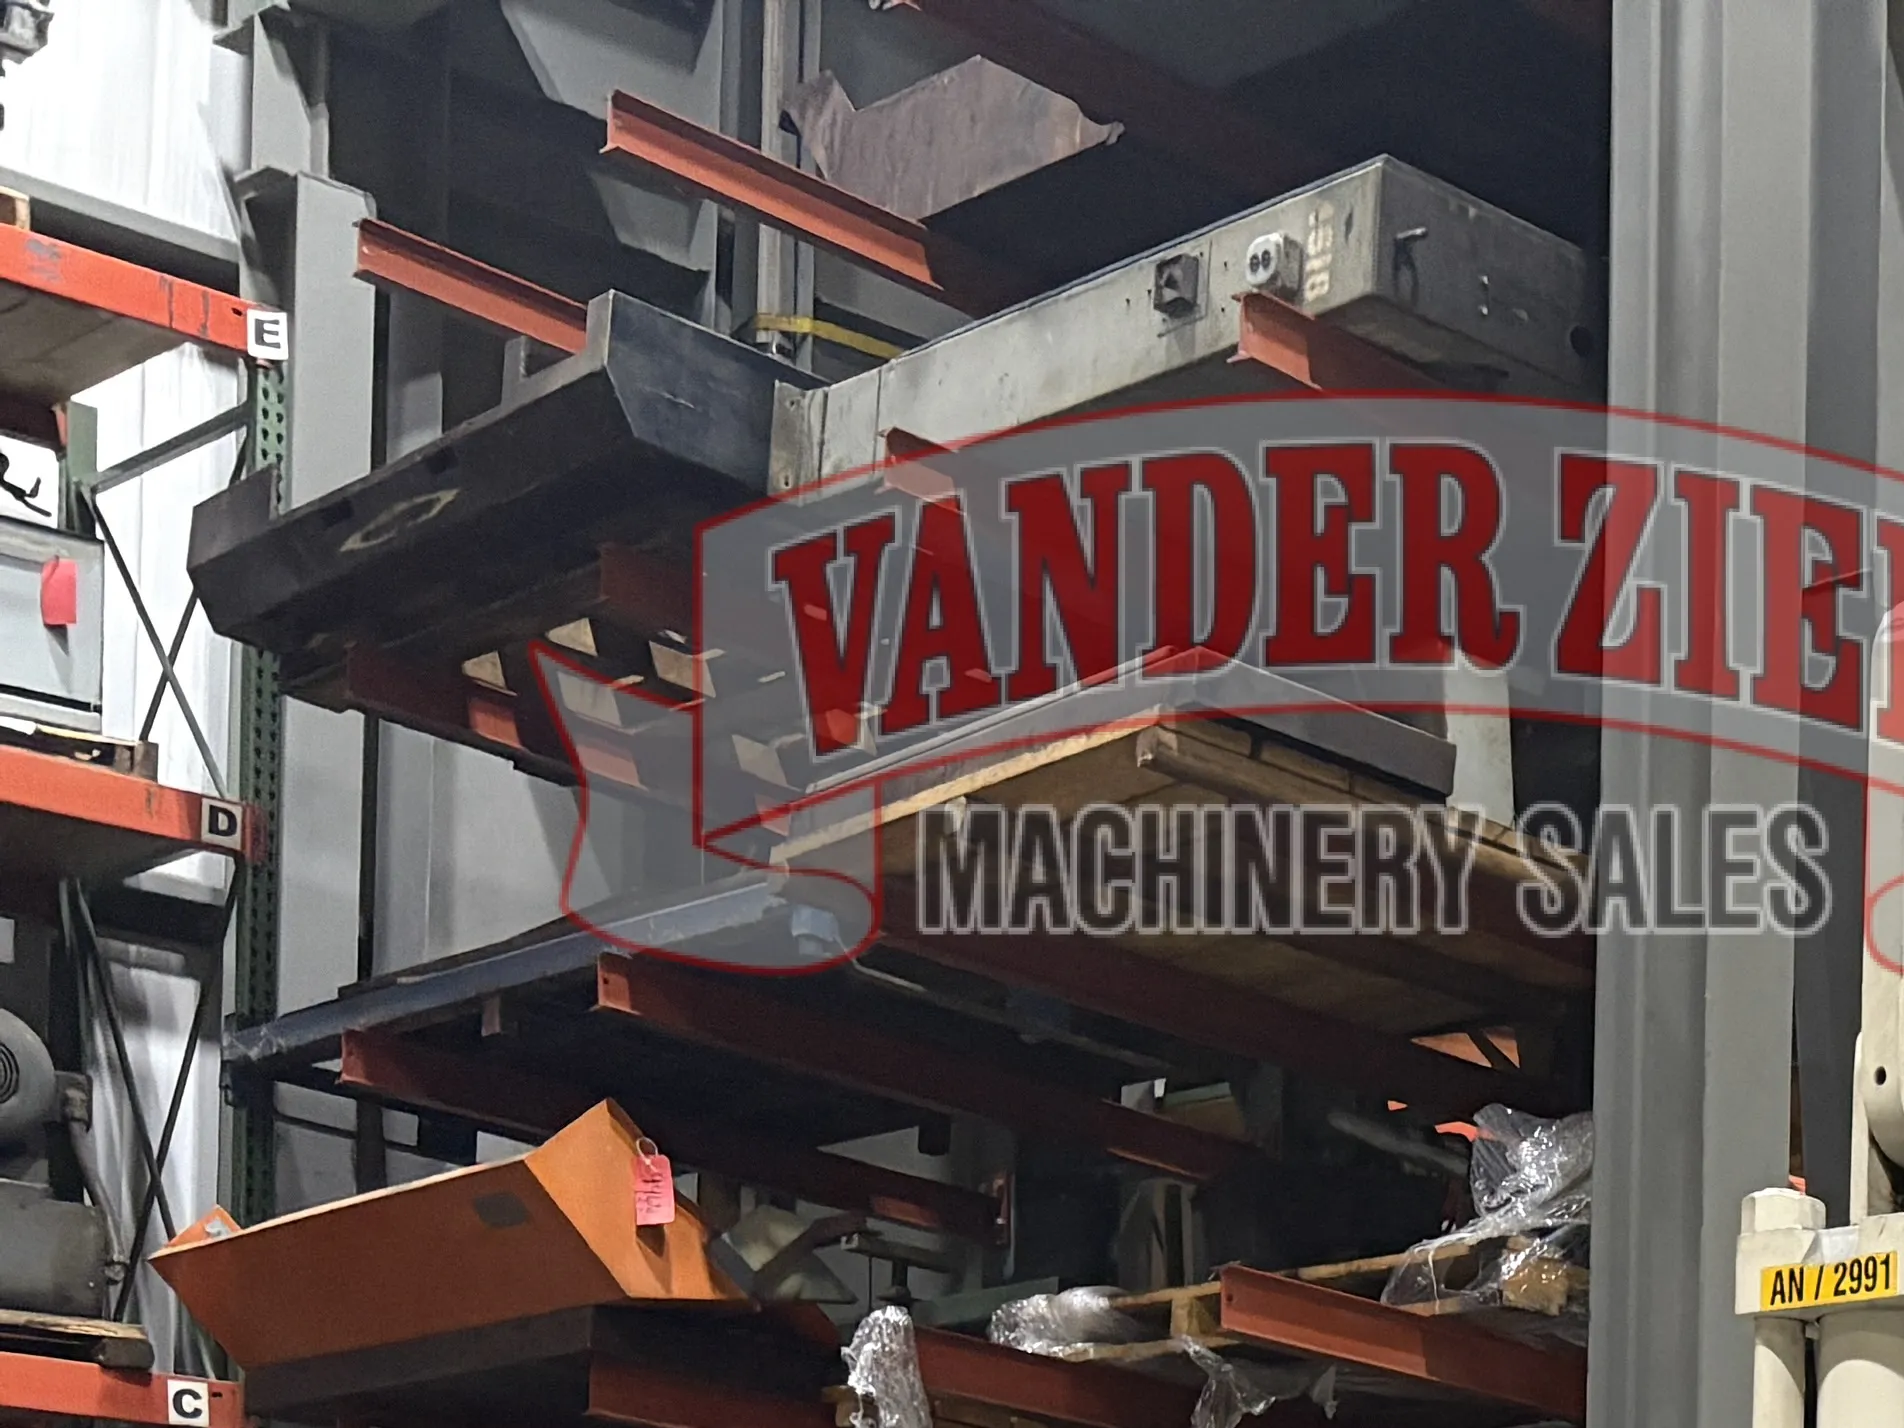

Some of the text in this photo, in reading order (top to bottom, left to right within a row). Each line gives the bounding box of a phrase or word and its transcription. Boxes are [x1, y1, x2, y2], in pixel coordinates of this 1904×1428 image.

[254, 318, 281, 349] E
[208, 804, 238, 837] D
[1770, 1253, 1891, 1306] AN / 2991
[172, 1388, 203, 1418] C
